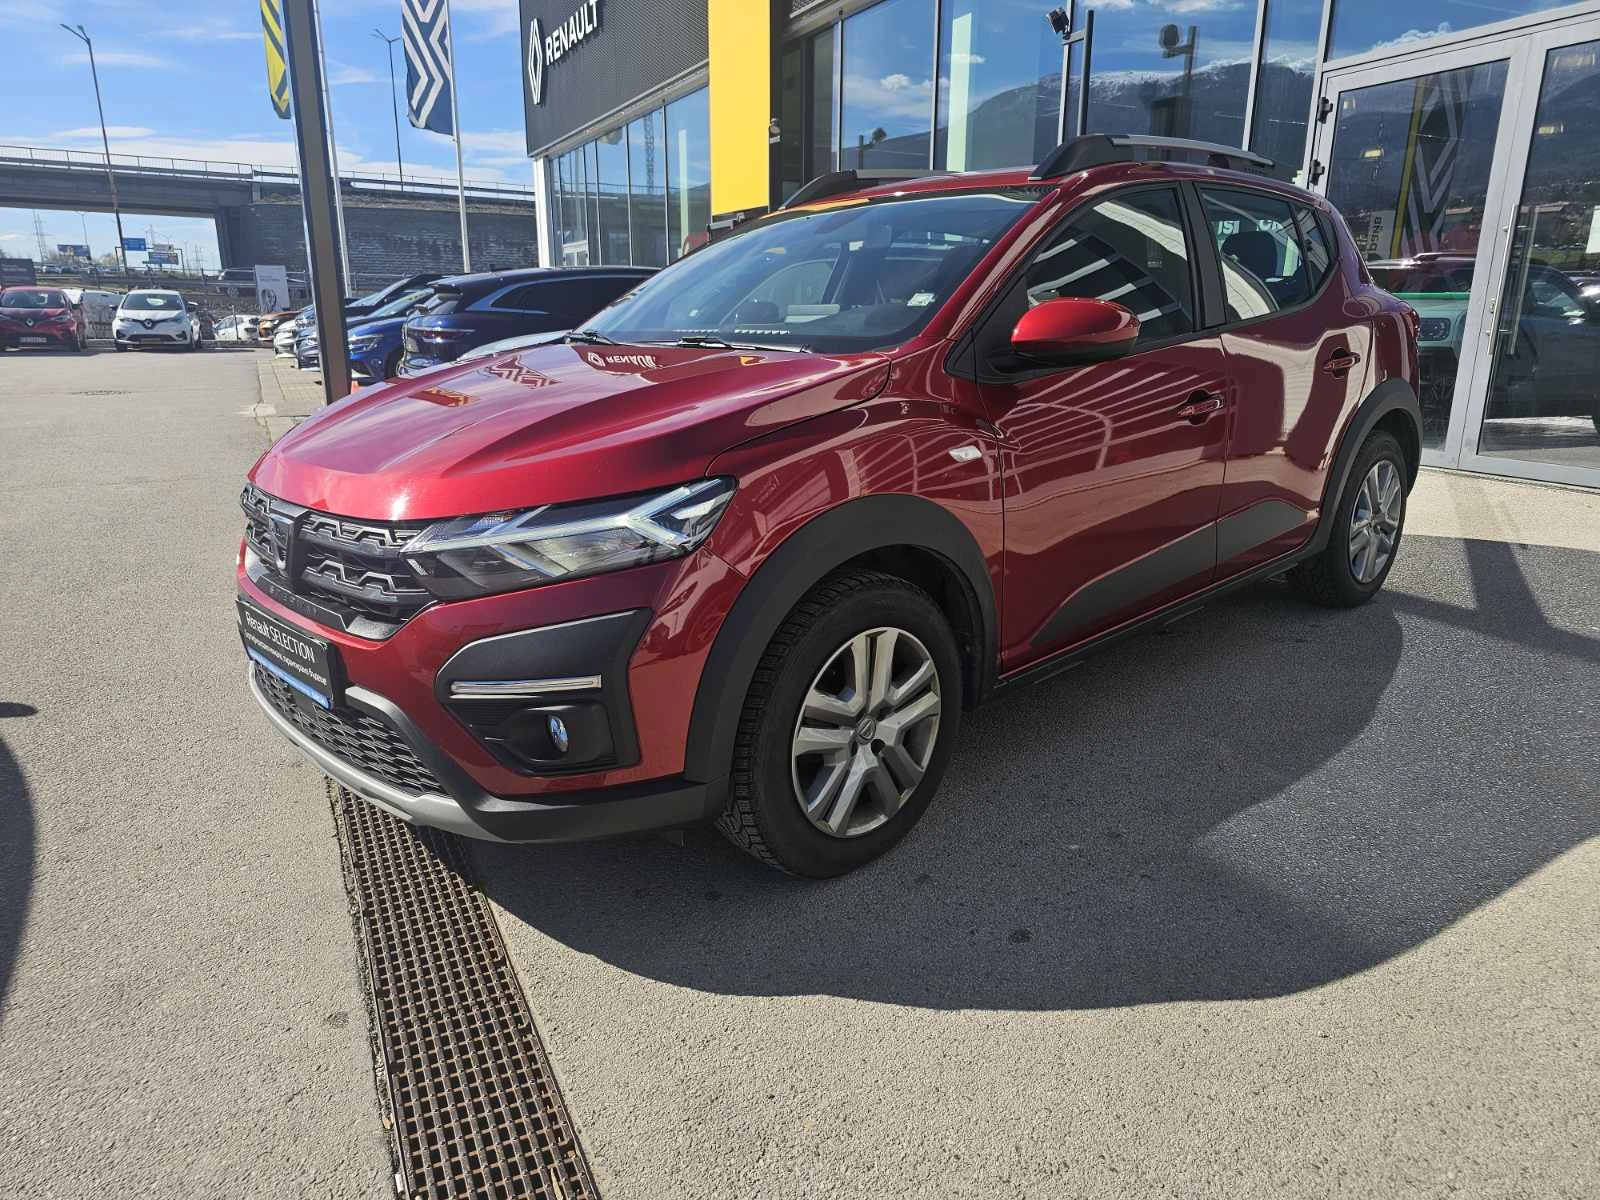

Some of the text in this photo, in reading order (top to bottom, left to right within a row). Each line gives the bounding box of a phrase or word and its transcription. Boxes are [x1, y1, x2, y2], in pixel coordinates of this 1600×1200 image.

[545, 0, 597, 66] RENAULT
[245, 611, 271, 639] Renault
[270, 626, 315, 663] SELECTION
